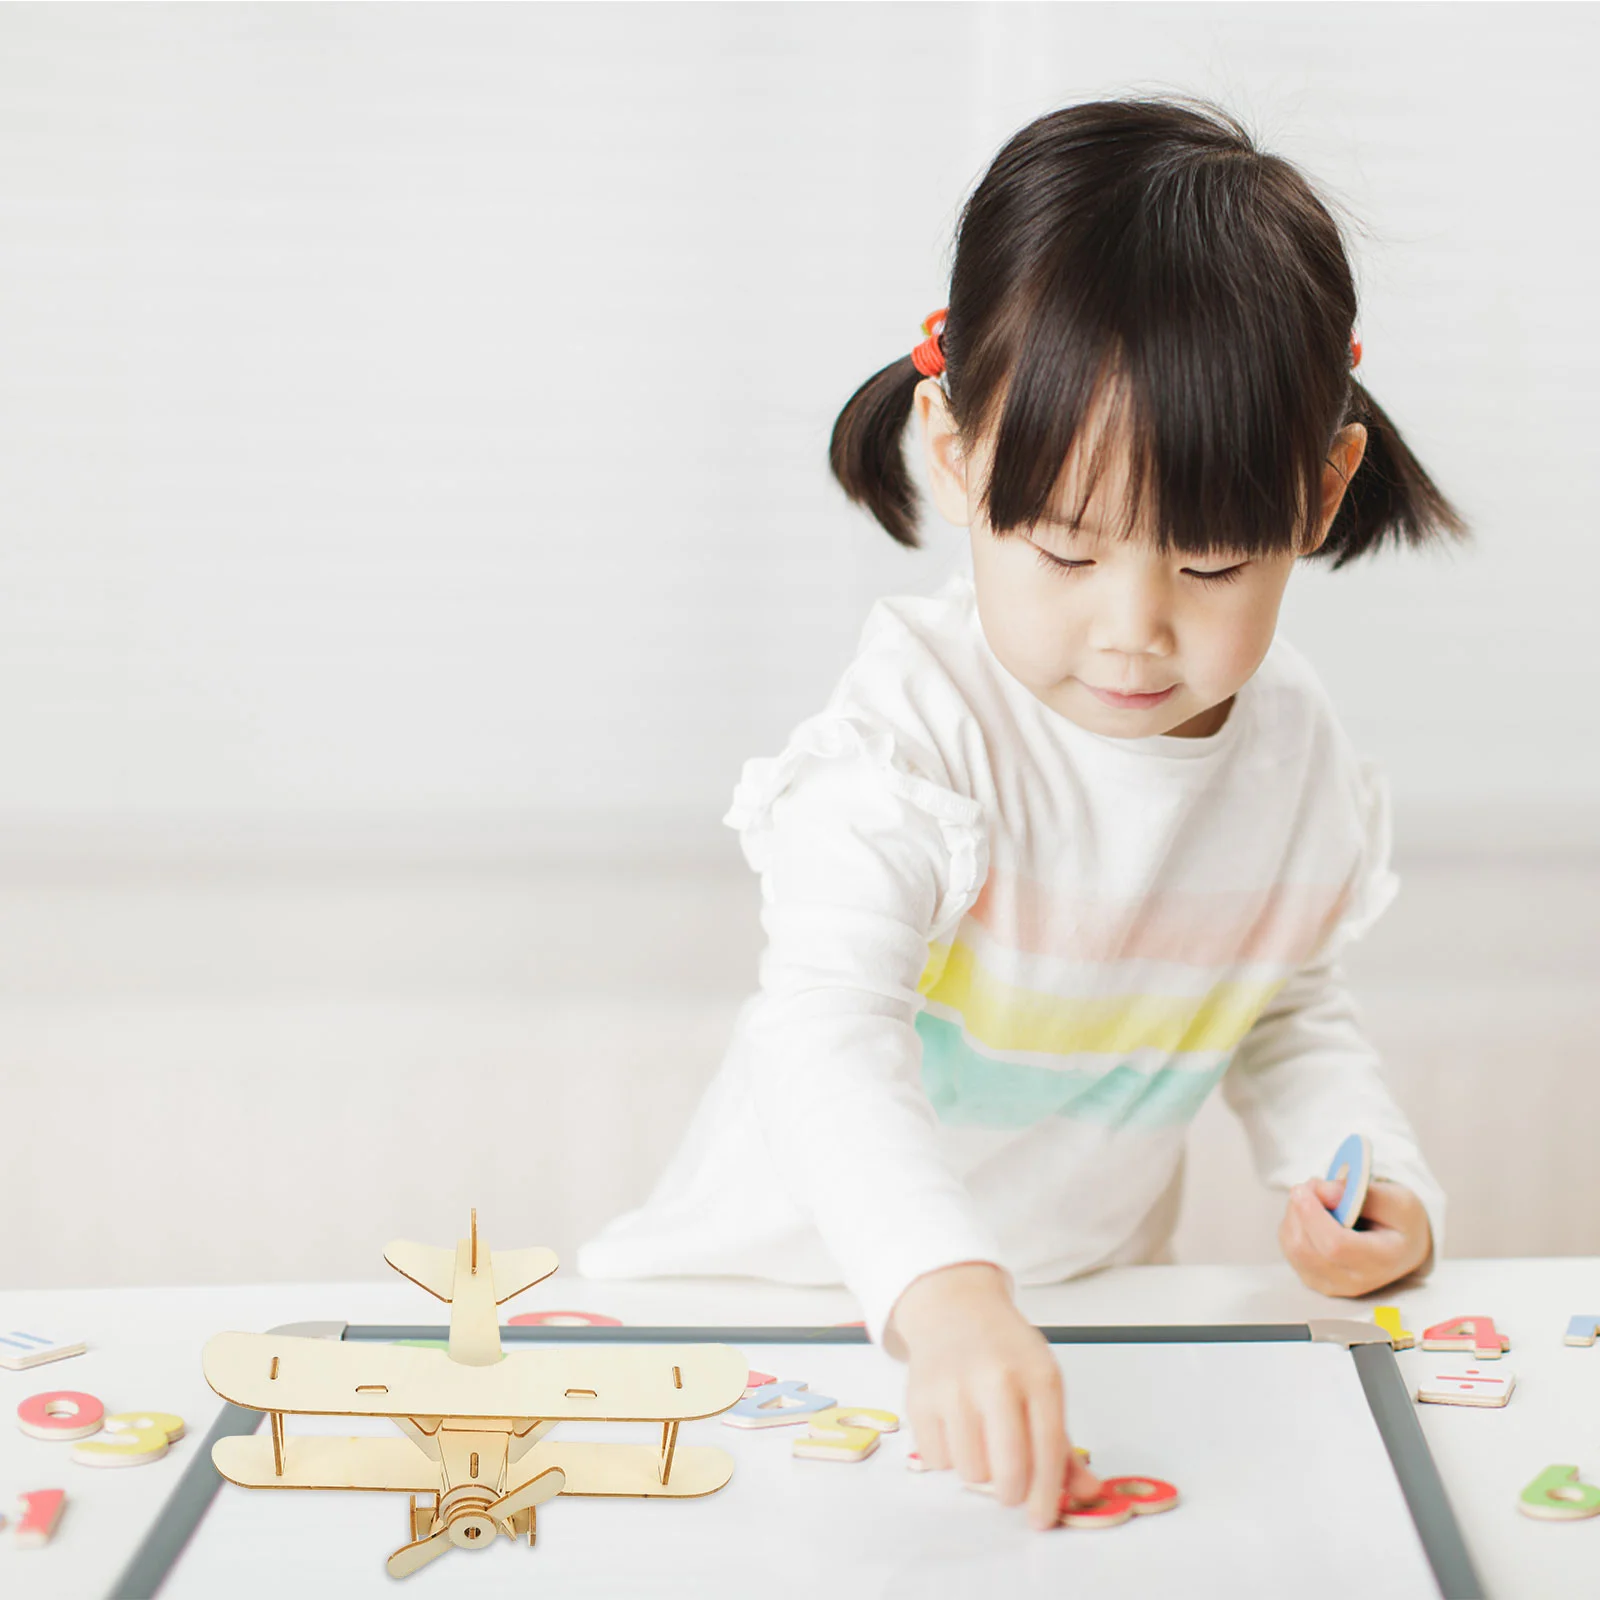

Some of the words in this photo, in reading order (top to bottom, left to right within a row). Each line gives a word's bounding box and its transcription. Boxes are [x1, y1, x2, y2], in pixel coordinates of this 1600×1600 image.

[1421, 1315, 1510, 1359] 4
[17, 1390, 105, 1440] 0
[70, 1411, 185, 1467] 3
[1058, 1475, 1180, 1528] 8
